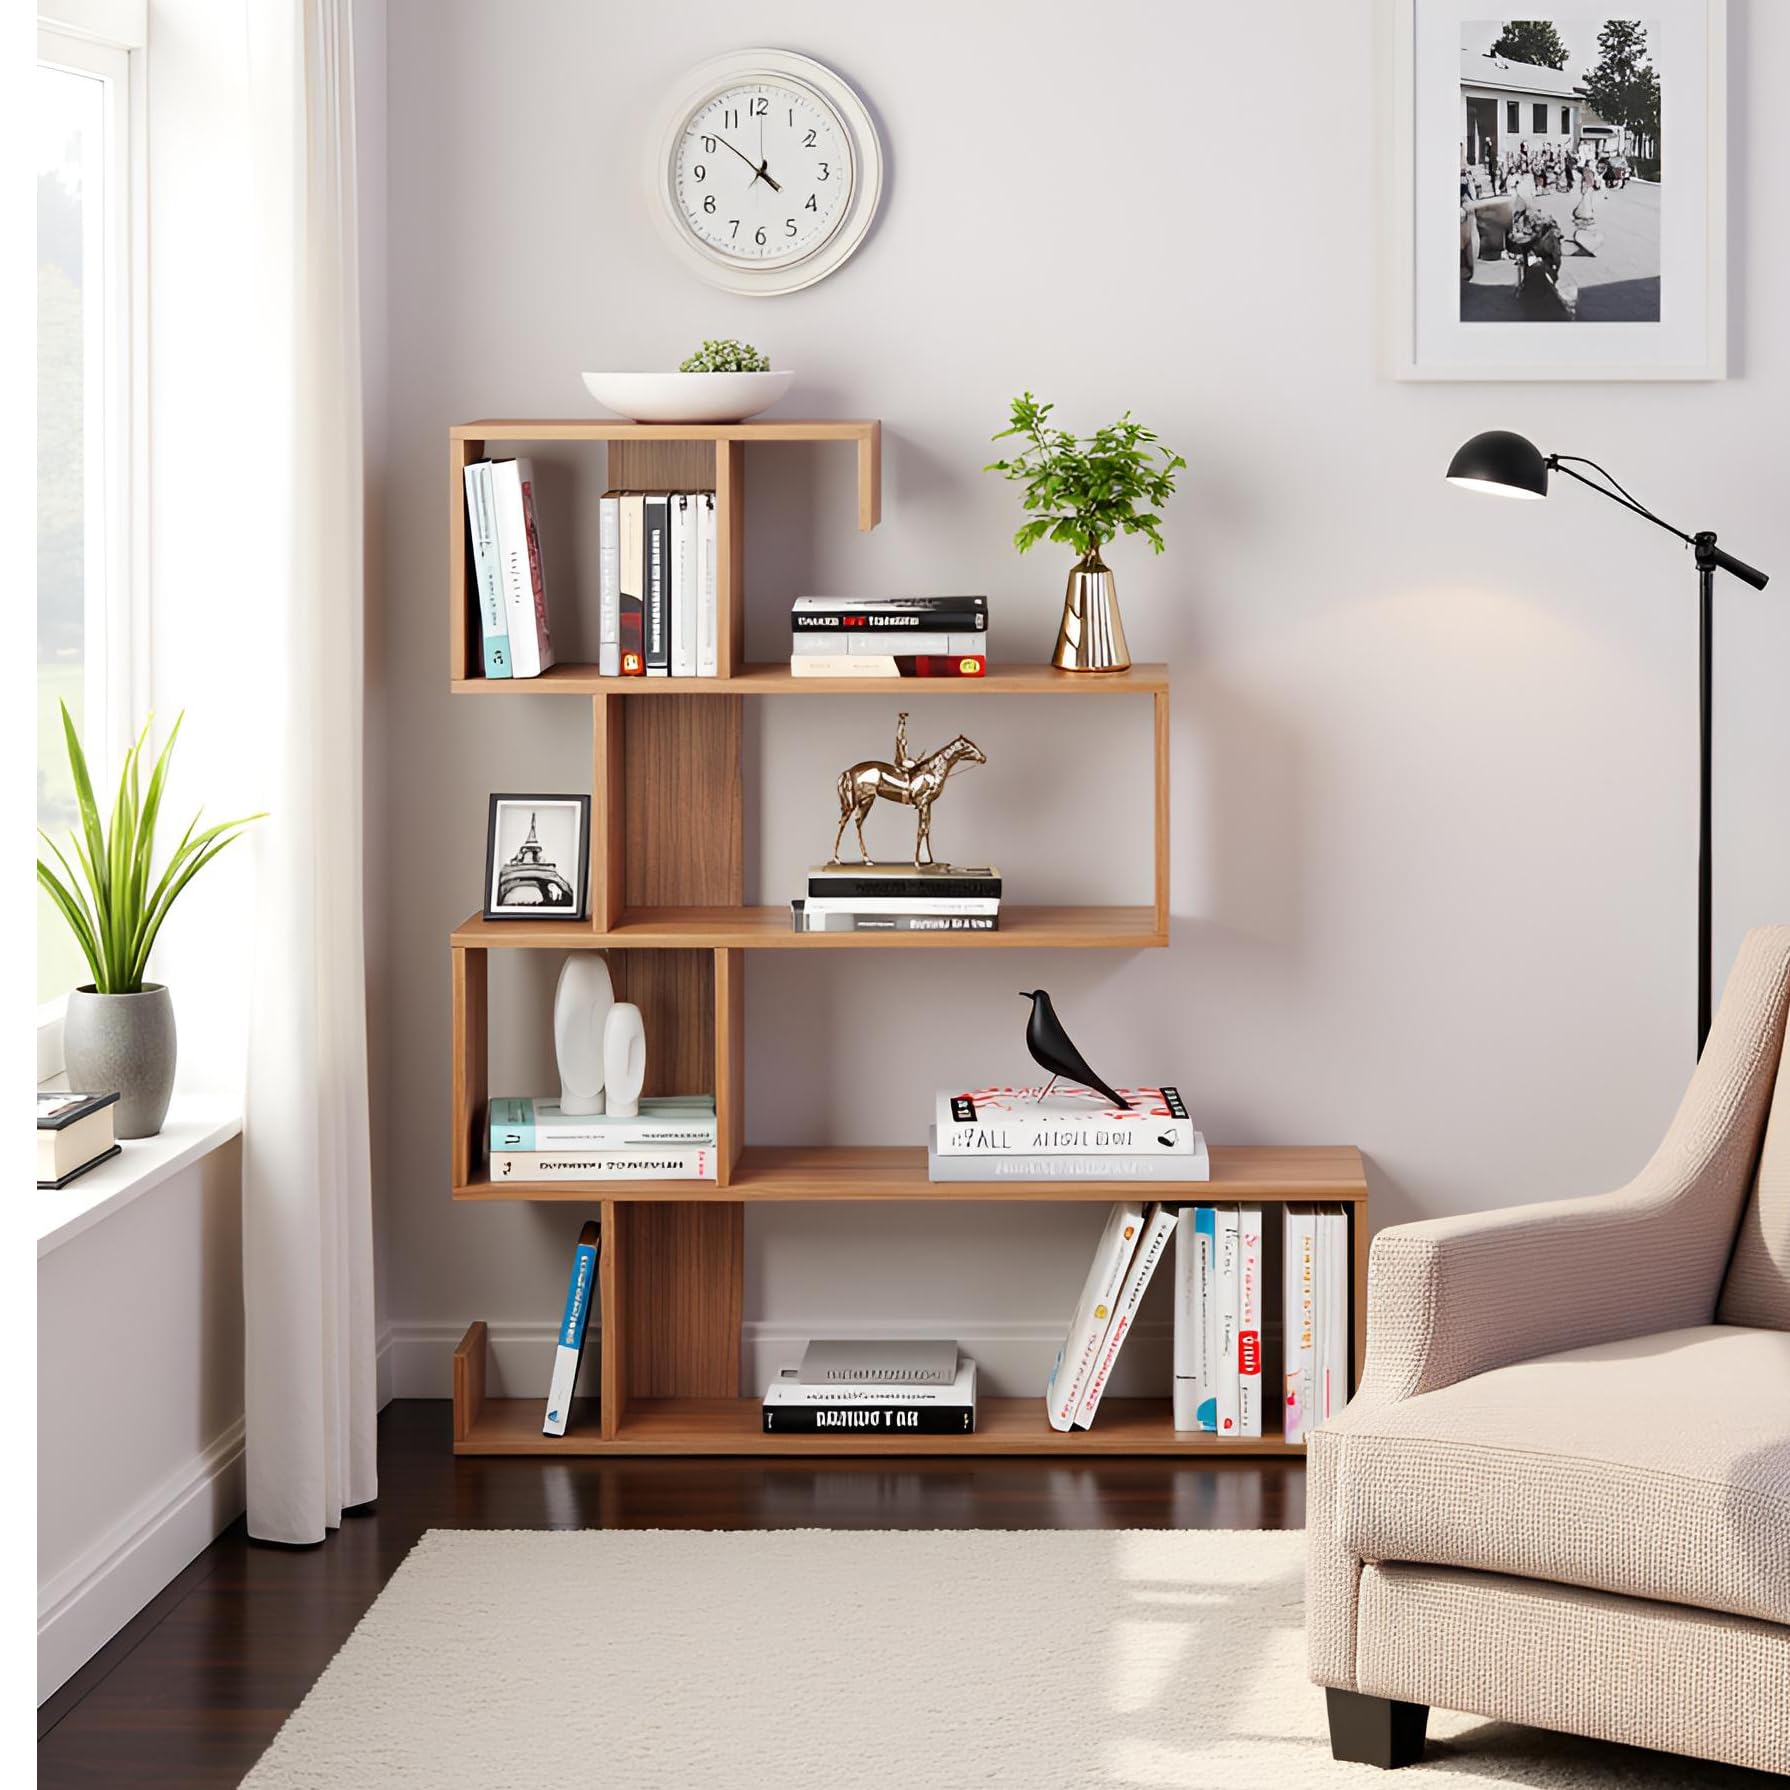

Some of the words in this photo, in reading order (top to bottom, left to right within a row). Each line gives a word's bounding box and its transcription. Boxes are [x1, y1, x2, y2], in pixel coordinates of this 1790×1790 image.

[749, 97, 769, 117] 12
[724, 109, 739, 129] 11
[801, 129, 817, 148] 2
[694, 164, 706, 183] 9
[816, 162, 830, 181] 3
[703, 195, 717, 214] 8
[804, 193, 818, 212] 4
[729, 220, 740, 239] 7
[755, 226, 767, 245] 6
[785, 218, 798, 237] 5
